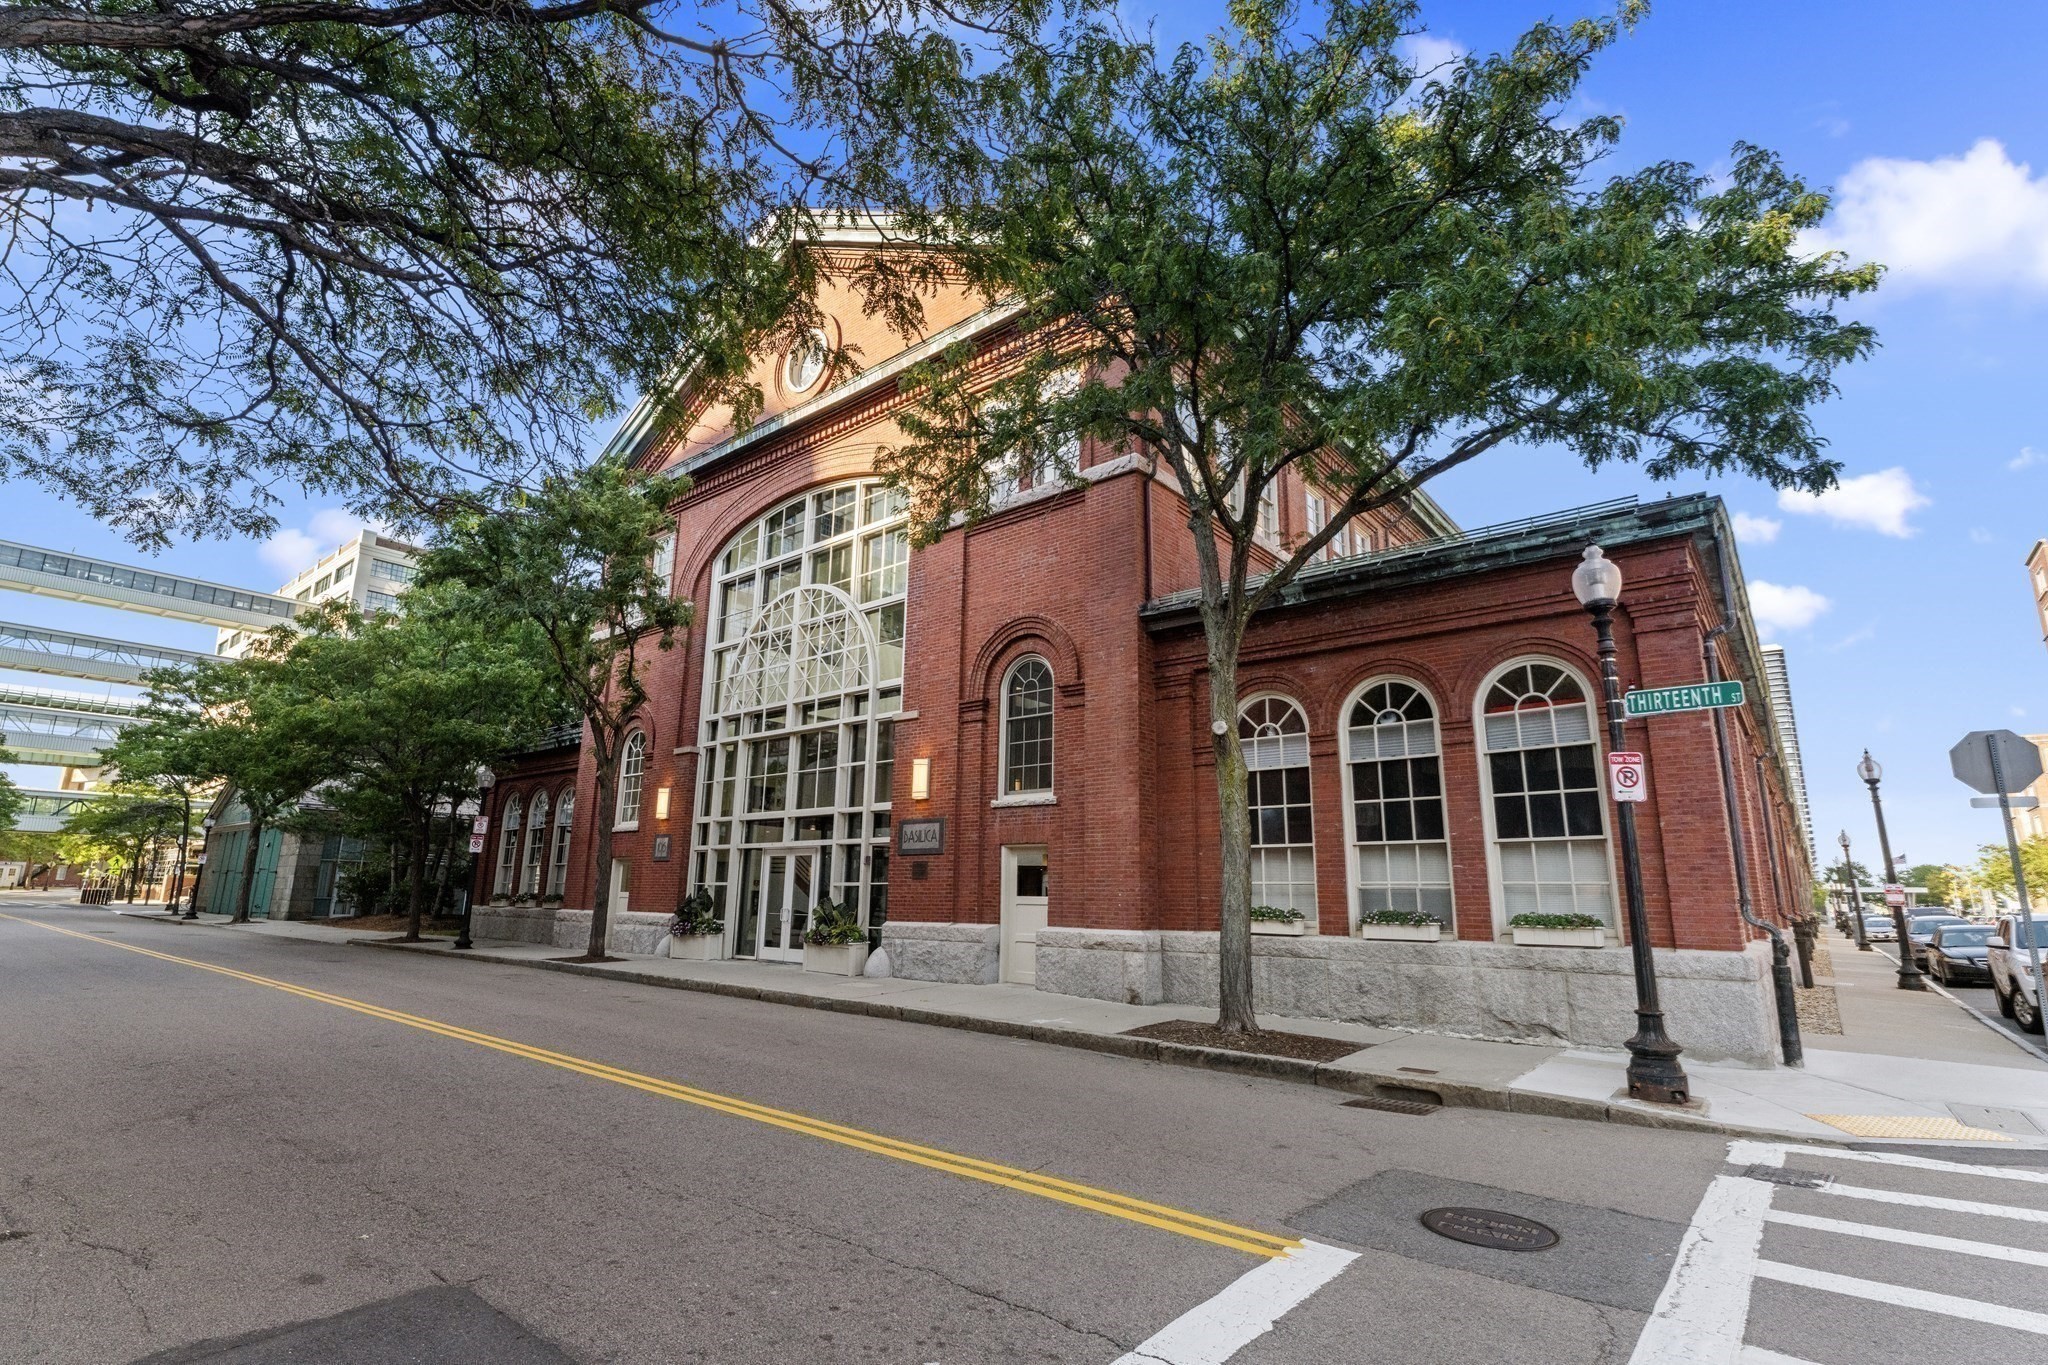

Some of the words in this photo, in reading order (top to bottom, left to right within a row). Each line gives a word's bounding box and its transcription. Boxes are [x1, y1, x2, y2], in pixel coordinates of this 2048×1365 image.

[1628, 686, 1722, 711] THIRTEENTH
[1731, 692, 1741, 703] ST
[1623, 755, 1640, 763] ZONE
[903, 829, 938, 844] BASILICA
